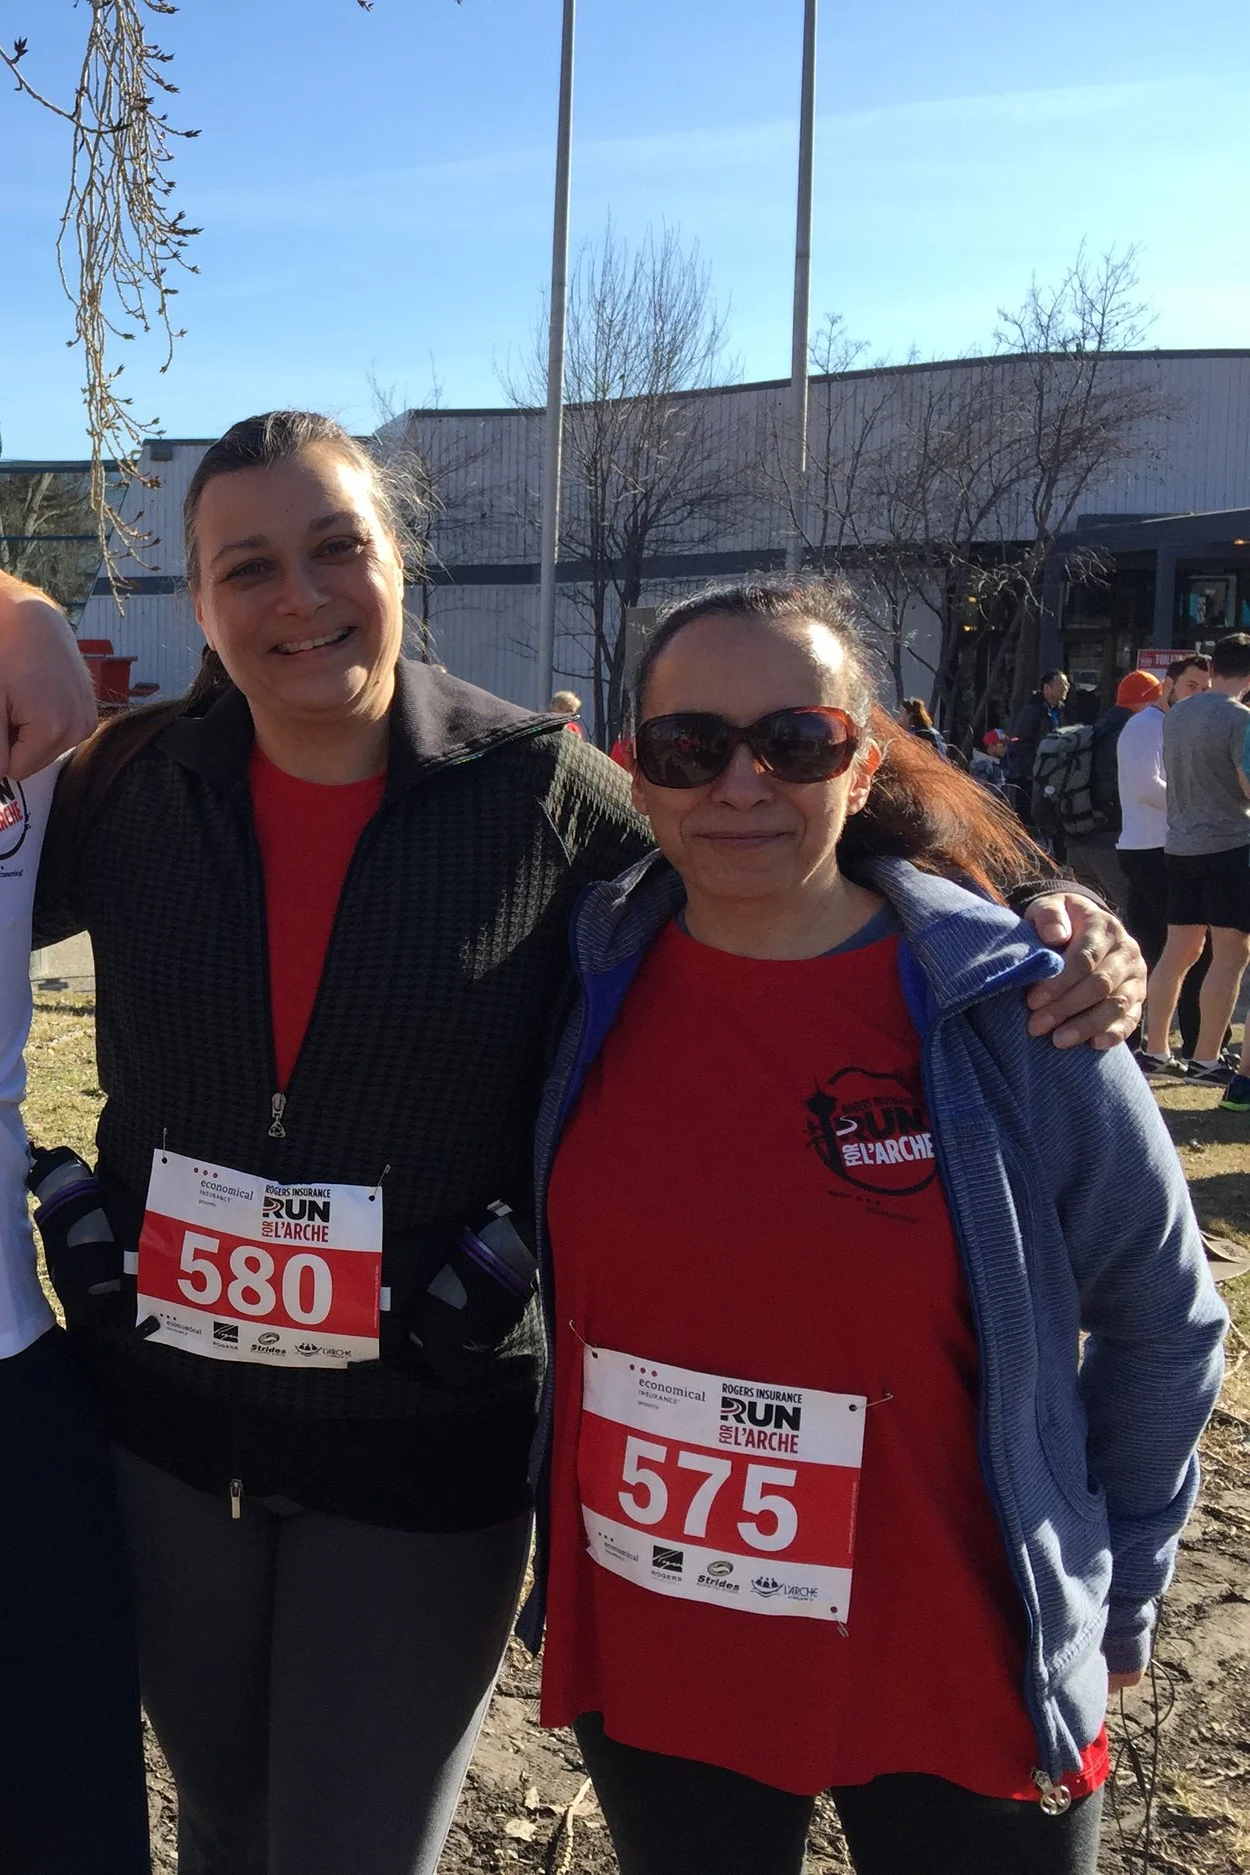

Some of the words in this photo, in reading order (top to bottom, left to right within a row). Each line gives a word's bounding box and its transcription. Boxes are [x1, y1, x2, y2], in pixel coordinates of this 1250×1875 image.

[834, 1106, 927, 1141] RUN
[842, 1143, 863, 1167] FOR
[861, 1133, 935, 1165] L'ARCHE
[200, 1179, 254, 1201] economical
[265, 1184, 291, 1197] ROGERS
[292, 1188, 330, 1198] INSURANCE
[262, 1196, 330, 1223] RUN
[262, 1221, 274, 1238] FOR
[274, 1221, 329, 1242] L'ARCHE
[177, 1230, 333, 1325] 580
[250, 1343, 287, 1355] Strides
[638, 1377, 706, 1402] economical
[638, 1390, 678, 1405] INSURANCE
[722, 1383, 754, 1398] ROGERS
[756, 1389, 803, 1404] INSURANCE
[720, 1396, 802, 1432] RUN
[719, 1424, 733, 1445] FOR
[733, 1426, 799, 1454] L'ARCHE
[618, 1434, 798, 1552] 575
[651, 1570, 683, 1582] ROGERS
[697, 1575, 740, 1591] Strides
[784, 1584, 818, 1598] L'ARCHE
